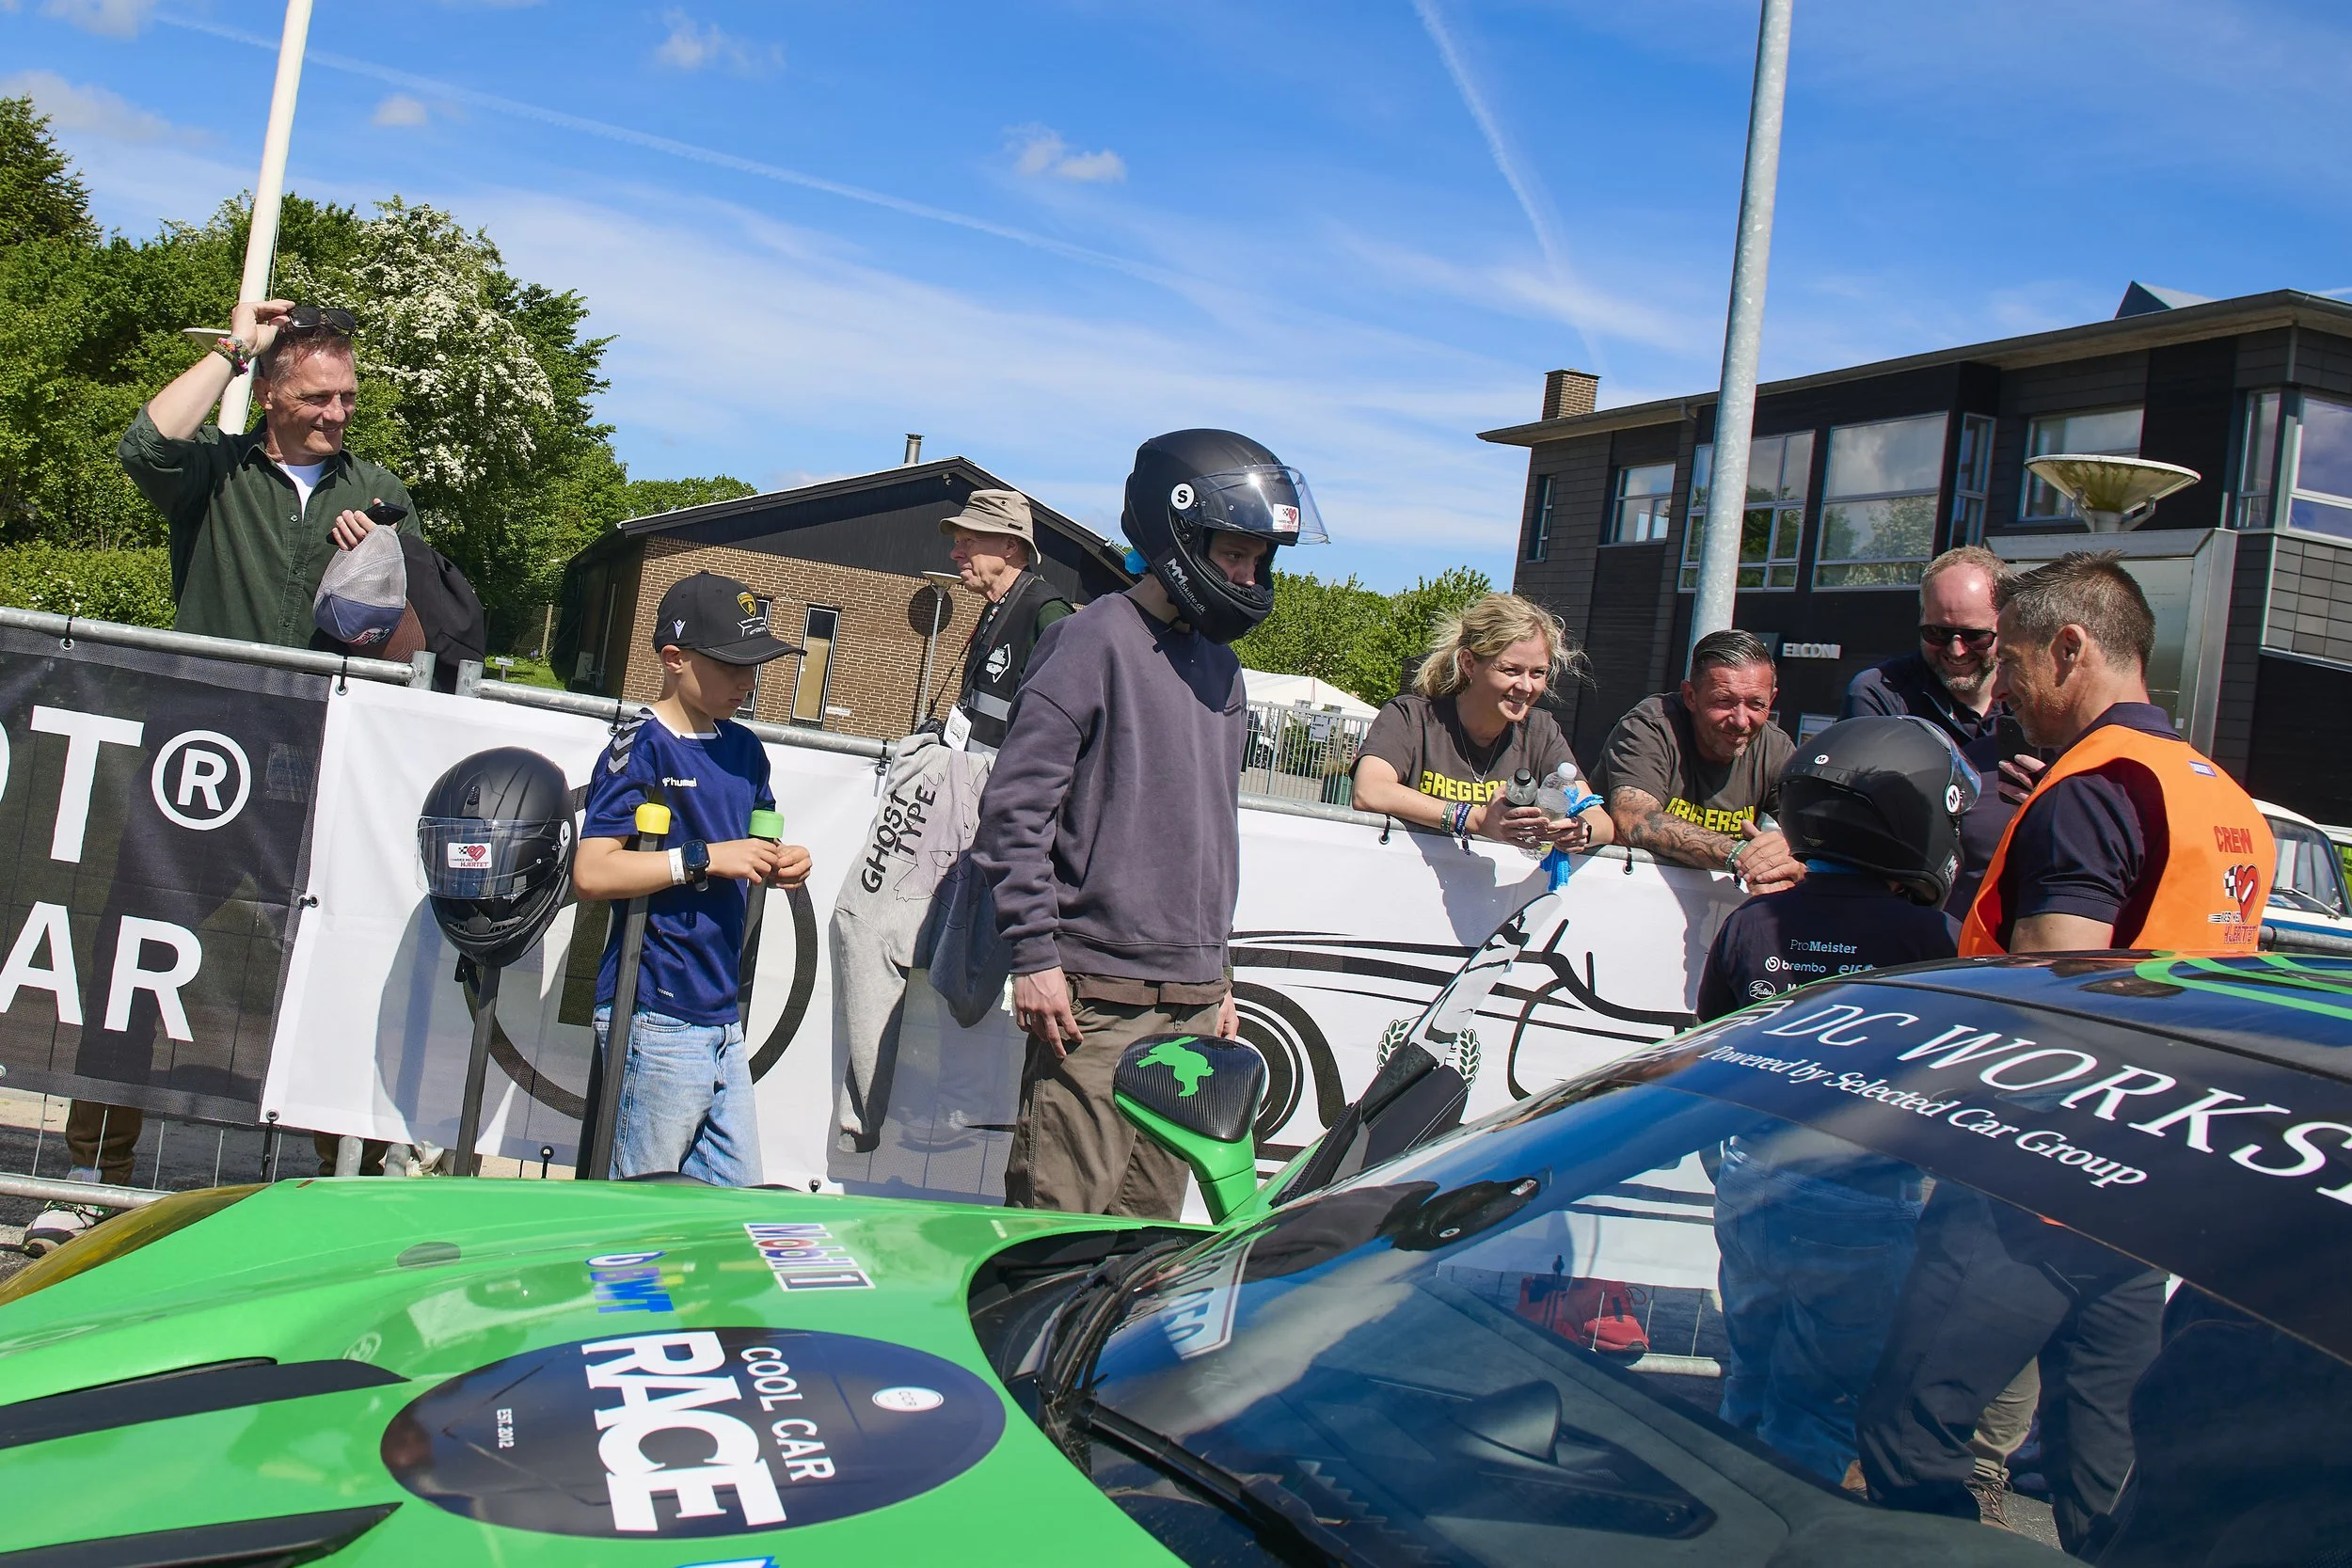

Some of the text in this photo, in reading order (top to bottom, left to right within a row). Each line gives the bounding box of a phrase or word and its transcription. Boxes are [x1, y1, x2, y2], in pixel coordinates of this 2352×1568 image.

[1177, 490, 1188, 503] S
[1419, 770, 1507, 802] GREGER
[1947, 791, 1959, 808] M
[563, 829, 568, 843] L
[894, 784, 936, 856] TYPE
[2214, 825, 2254, 854] CREW
[862, 789, 909, 894] GHOST
[1781, 959, 1827, 974] brembo
[1789, 939, 1857, 955] ProMeister
[1697, 1045, 2148, 1189] Powered by Selected Car Group
[742, 1223, 860, 1271] Mobil
[589, 1266, 675, 1313] BWT
[580, 1331, 787, 1532] RACE
[740, 1346, 836, 1481] COOL CAR
